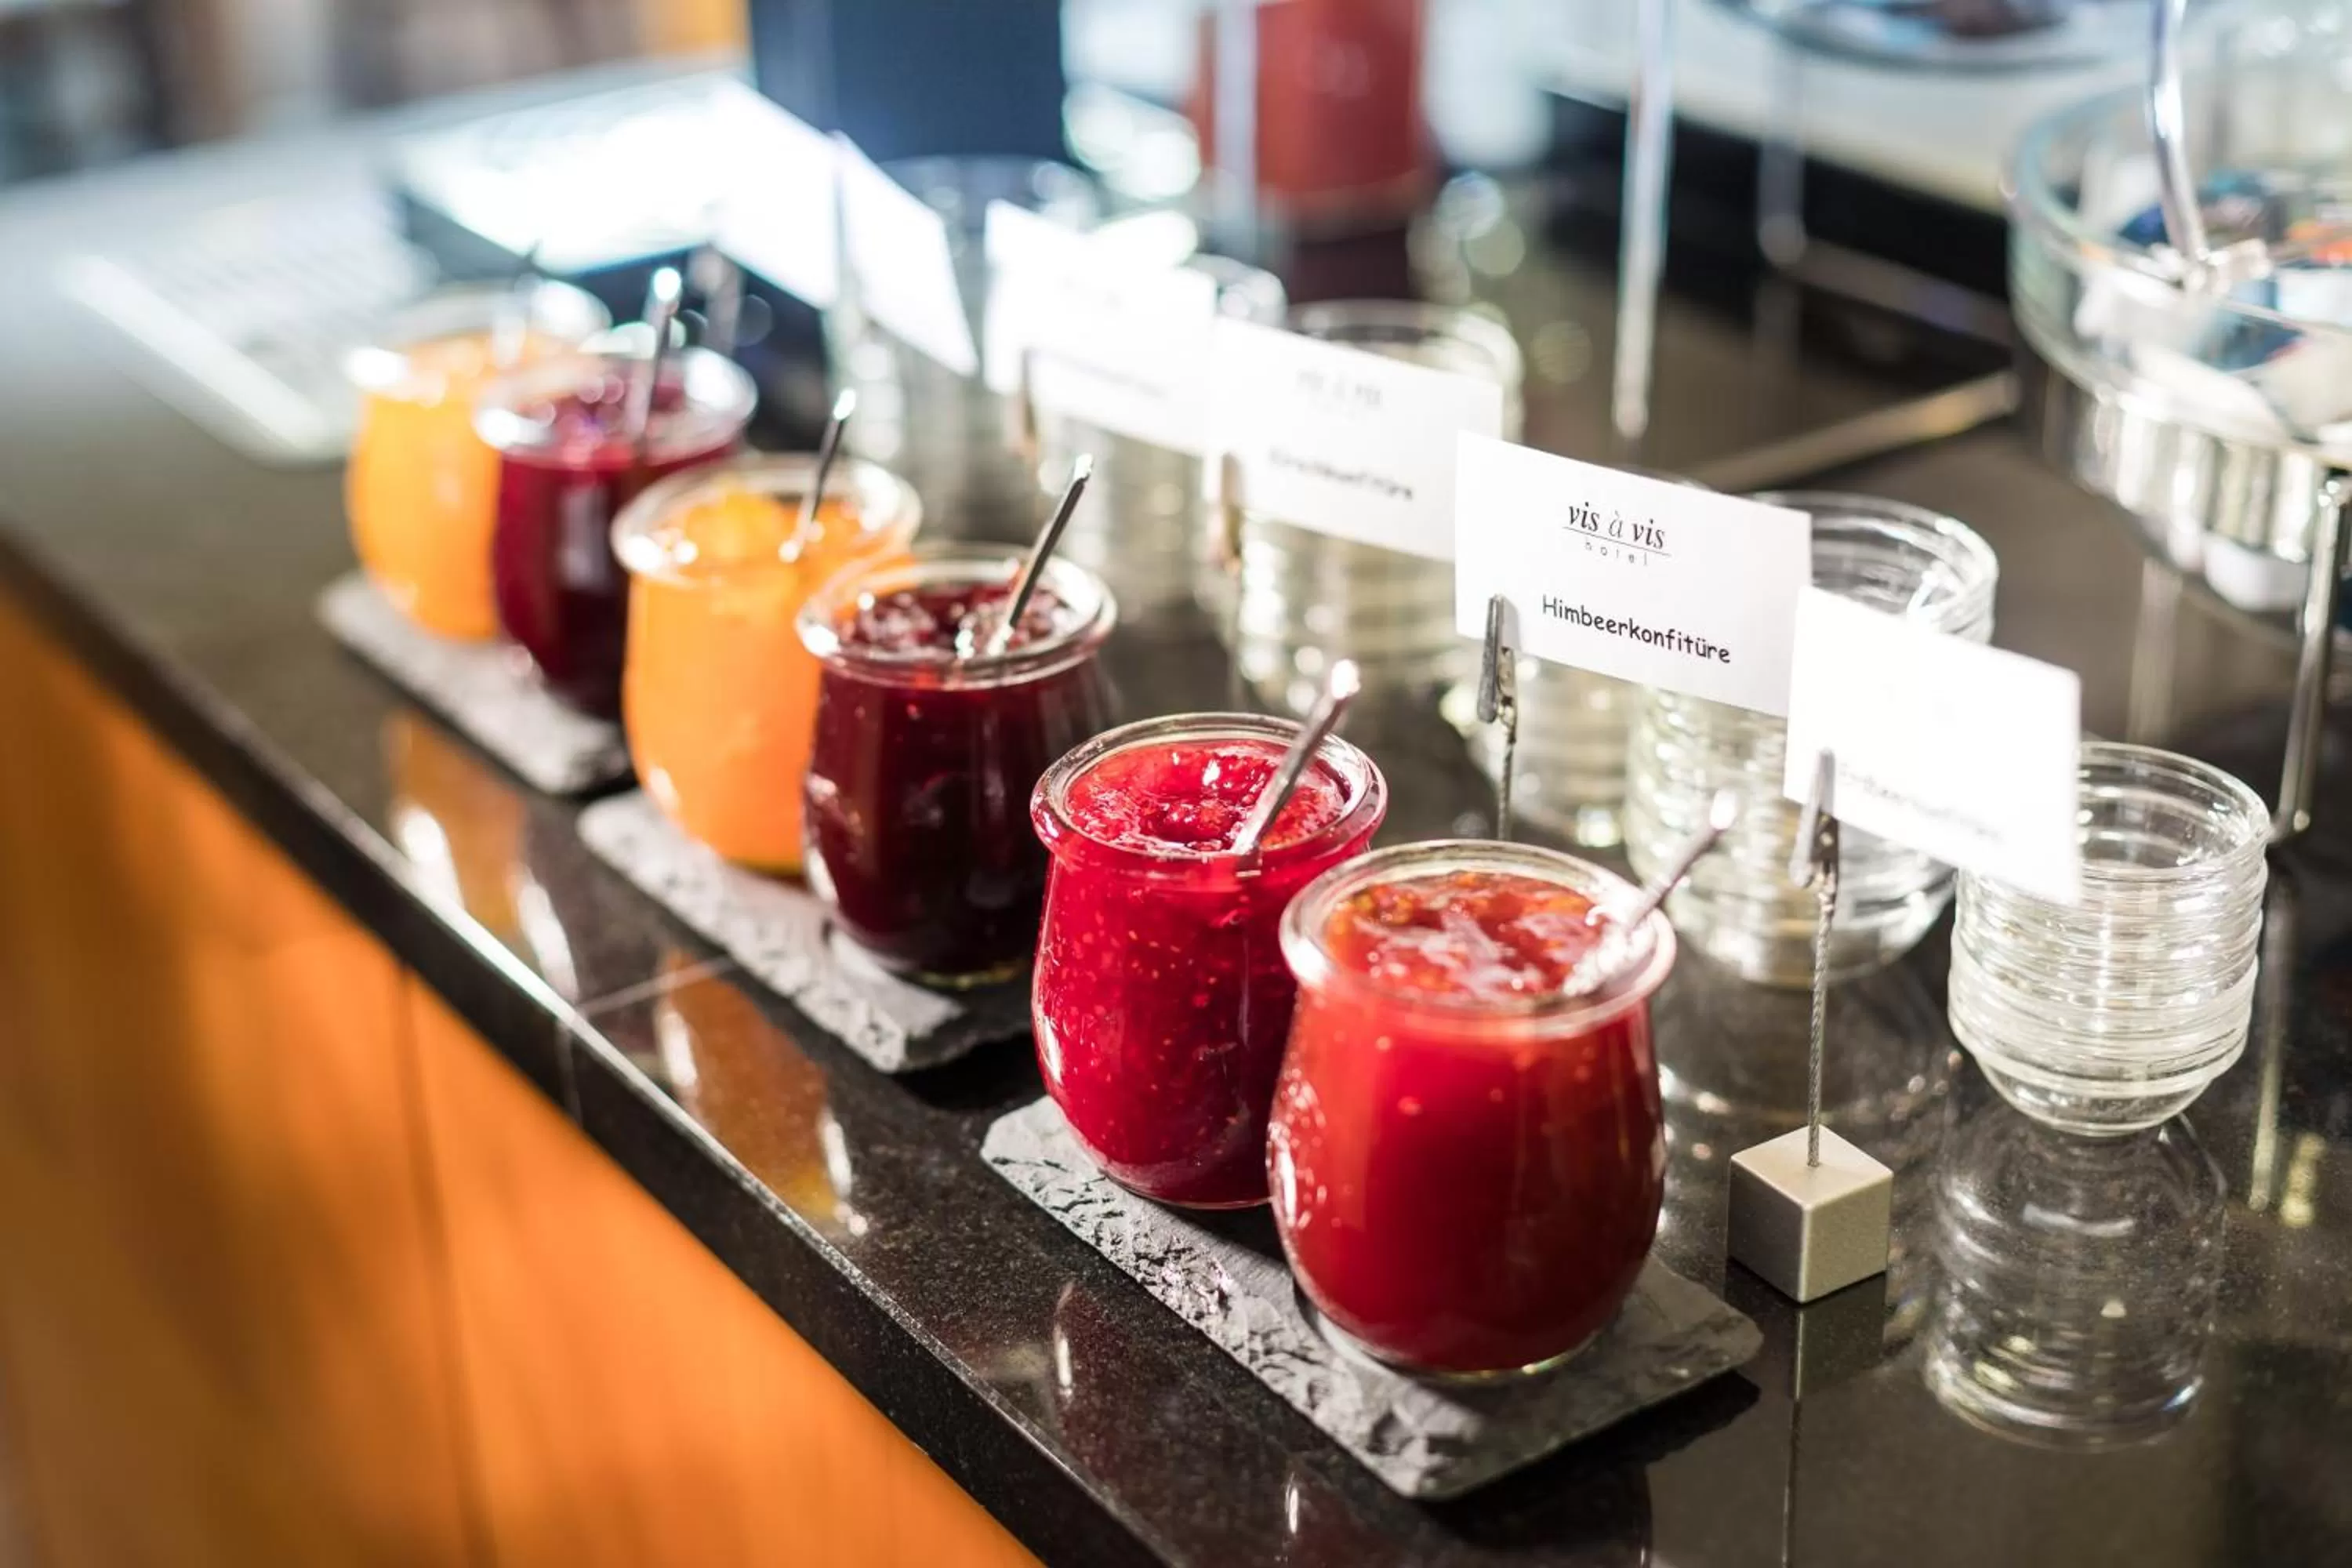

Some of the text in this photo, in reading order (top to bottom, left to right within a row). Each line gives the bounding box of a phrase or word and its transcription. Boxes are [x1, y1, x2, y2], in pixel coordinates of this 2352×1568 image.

[1569, 502, 1665, 550] vis à vis
[1542, 594, 1731, 664] Himbeerkonfitüre
